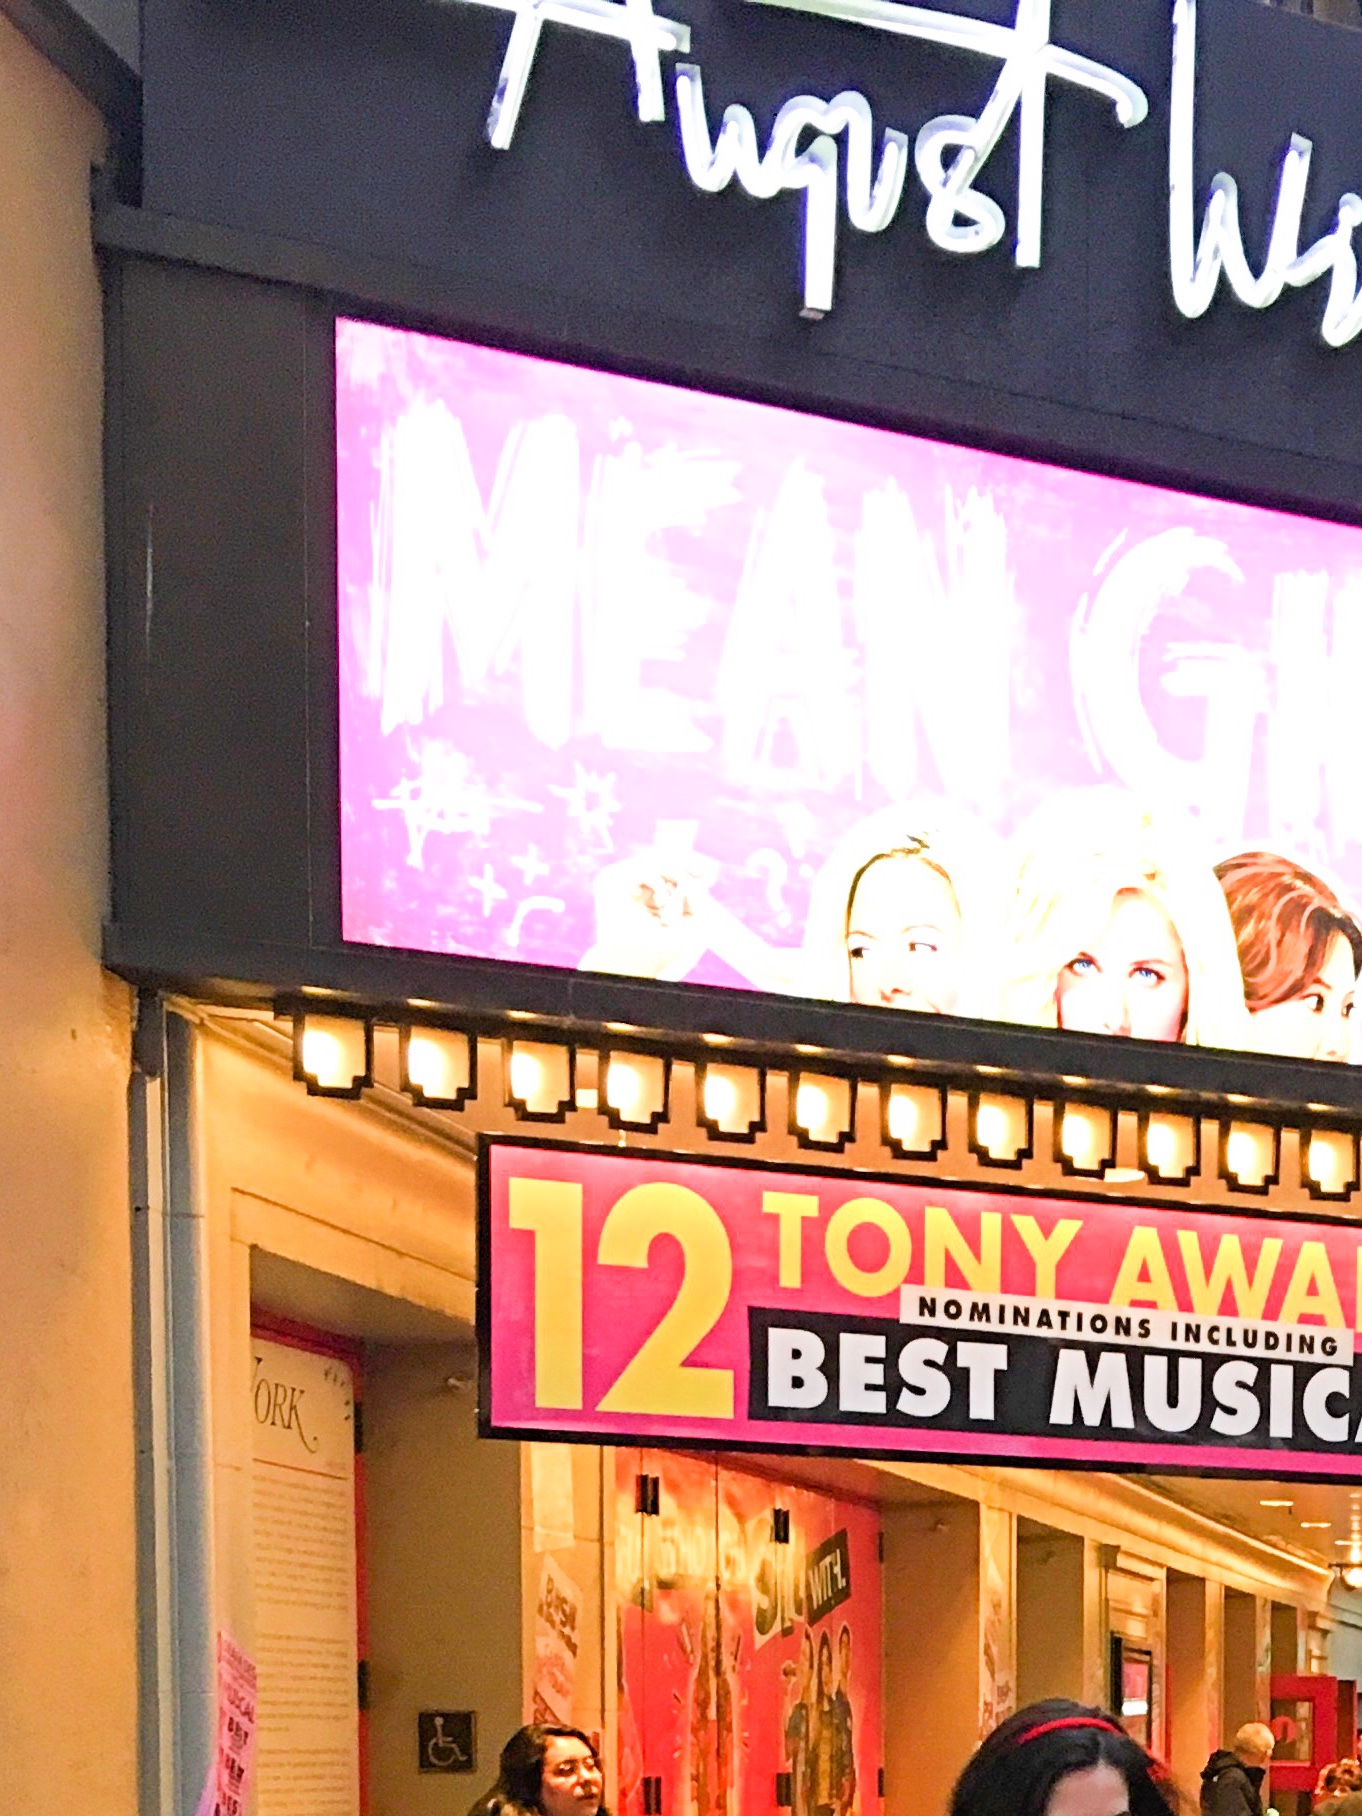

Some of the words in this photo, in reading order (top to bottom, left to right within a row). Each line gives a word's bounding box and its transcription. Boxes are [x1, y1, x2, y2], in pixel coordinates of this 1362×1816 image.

[368, 396, 1018, 832] MEAN
[508, 1176, 734, 1420] 12
[761, 1190, 1084, 1302] TONY
[765, 1327, 1009, 1421] BEST
[917, 1296, 1153, 1340] NOMINATIONS
[1170, 1321, 1340, 1358] INCLUDING
